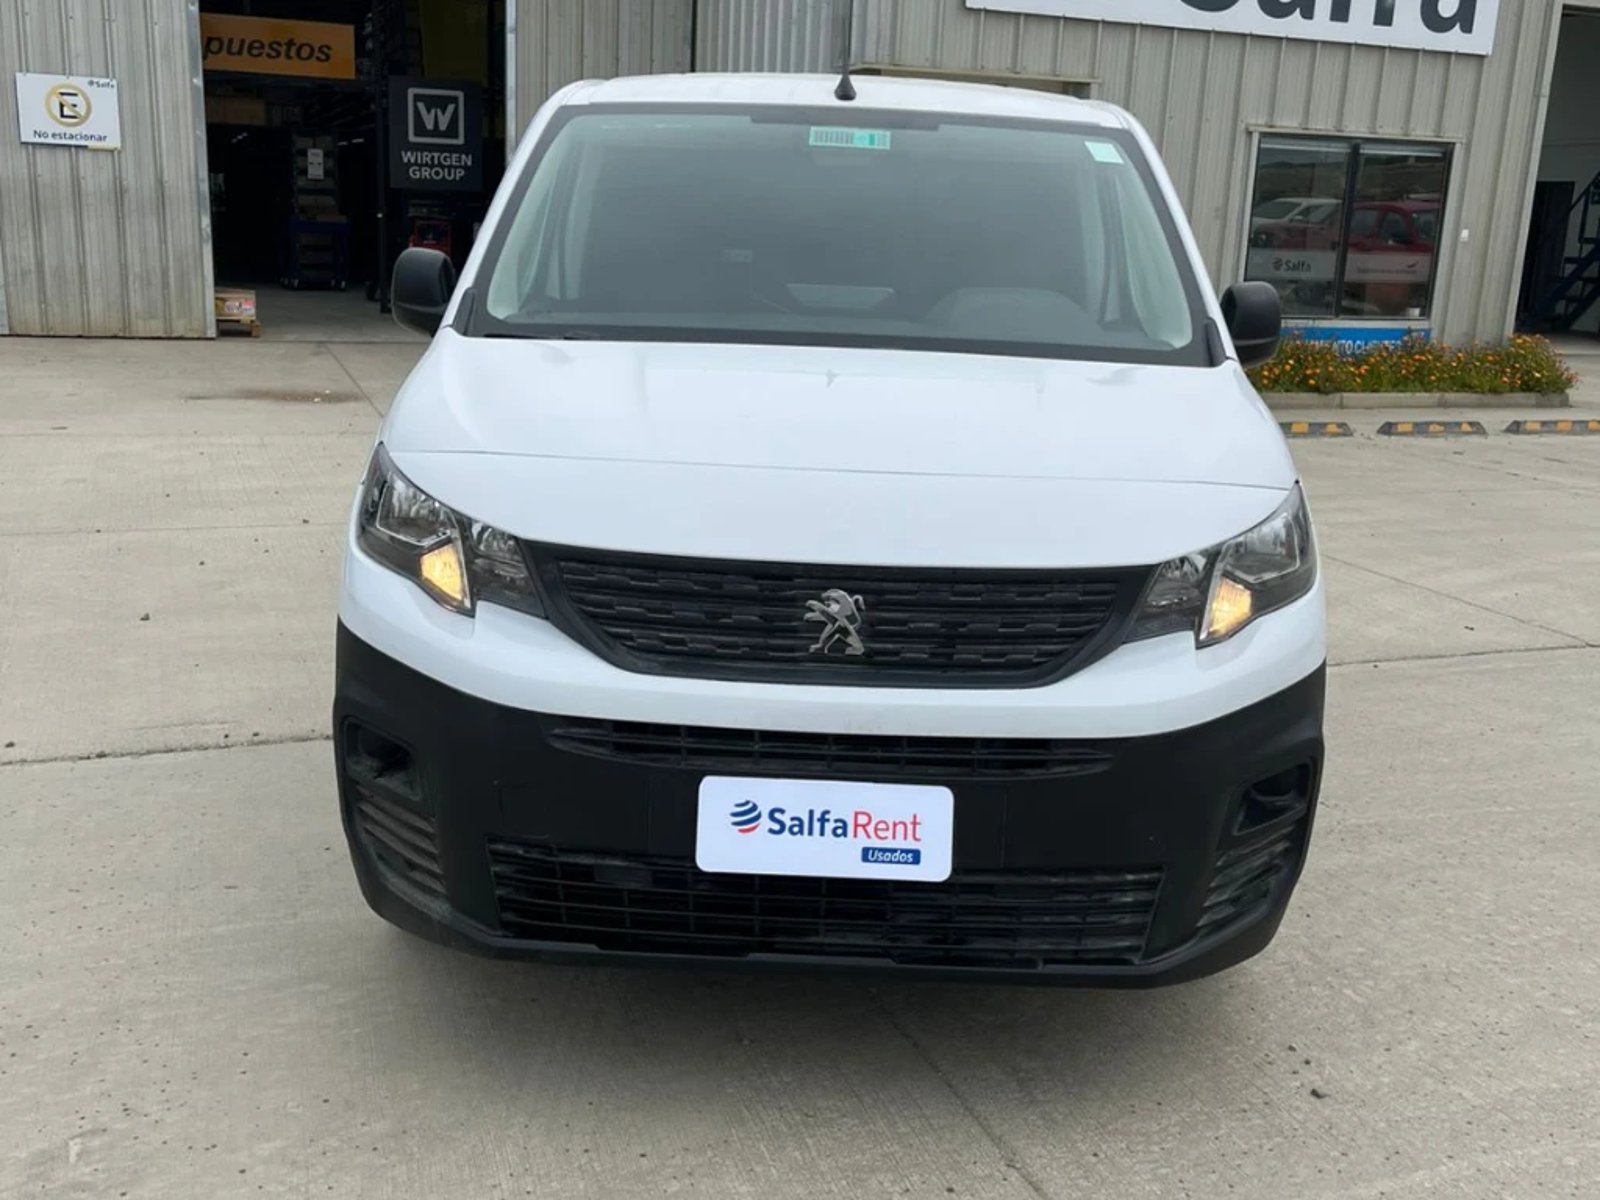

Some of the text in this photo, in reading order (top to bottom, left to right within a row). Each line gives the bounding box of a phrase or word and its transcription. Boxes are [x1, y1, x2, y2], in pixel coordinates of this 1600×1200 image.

[33, 130, 107, 141] No estacionar
[401, 150, 472, 167] WIRTGEN
[408, 165, 465, 181] GROUP
[767, 807, 922, 842] SalfaRent
[868, 850, 914, 863] Usados
